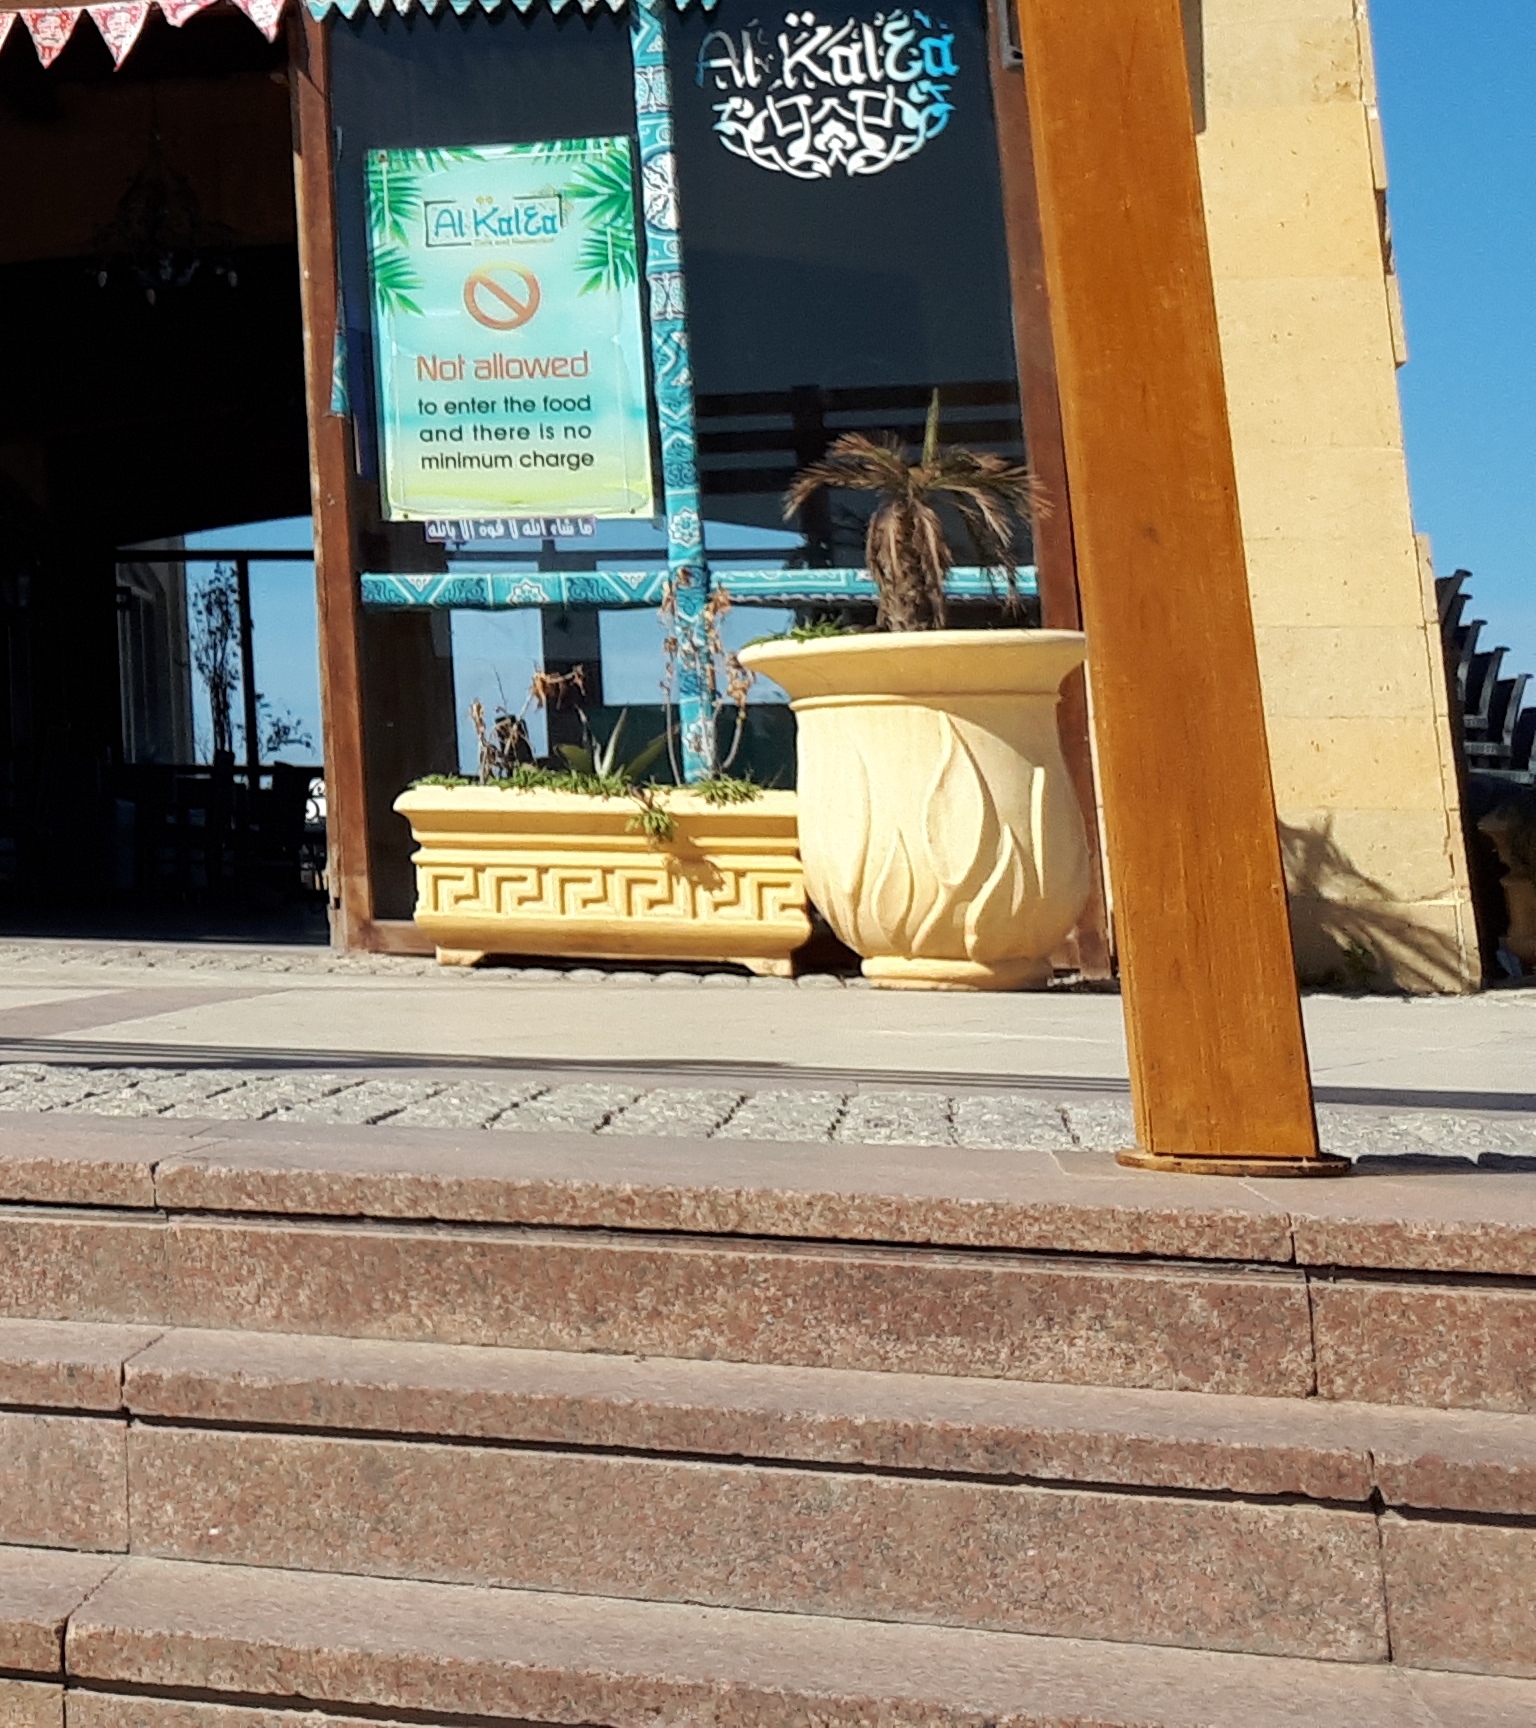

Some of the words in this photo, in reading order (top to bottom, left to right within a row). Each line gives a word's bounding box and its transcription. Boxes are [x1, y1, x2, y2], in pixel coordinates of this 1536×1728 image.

[417, 353, 465, 381] Not
[473, 350, 590, 380] allowed
[418, 397, 438, 415] to
[444, 397, 497, 415] enter
[503, 395, 536, 413] the
[543, 394, 591, 413] food
[419, 424, 463, 442] and
[473, 424, 530, 441] there
[564, 424, 592, 440] no
[421, 451, 513, 470] minimum
[519, 450, 594, 472] charge
